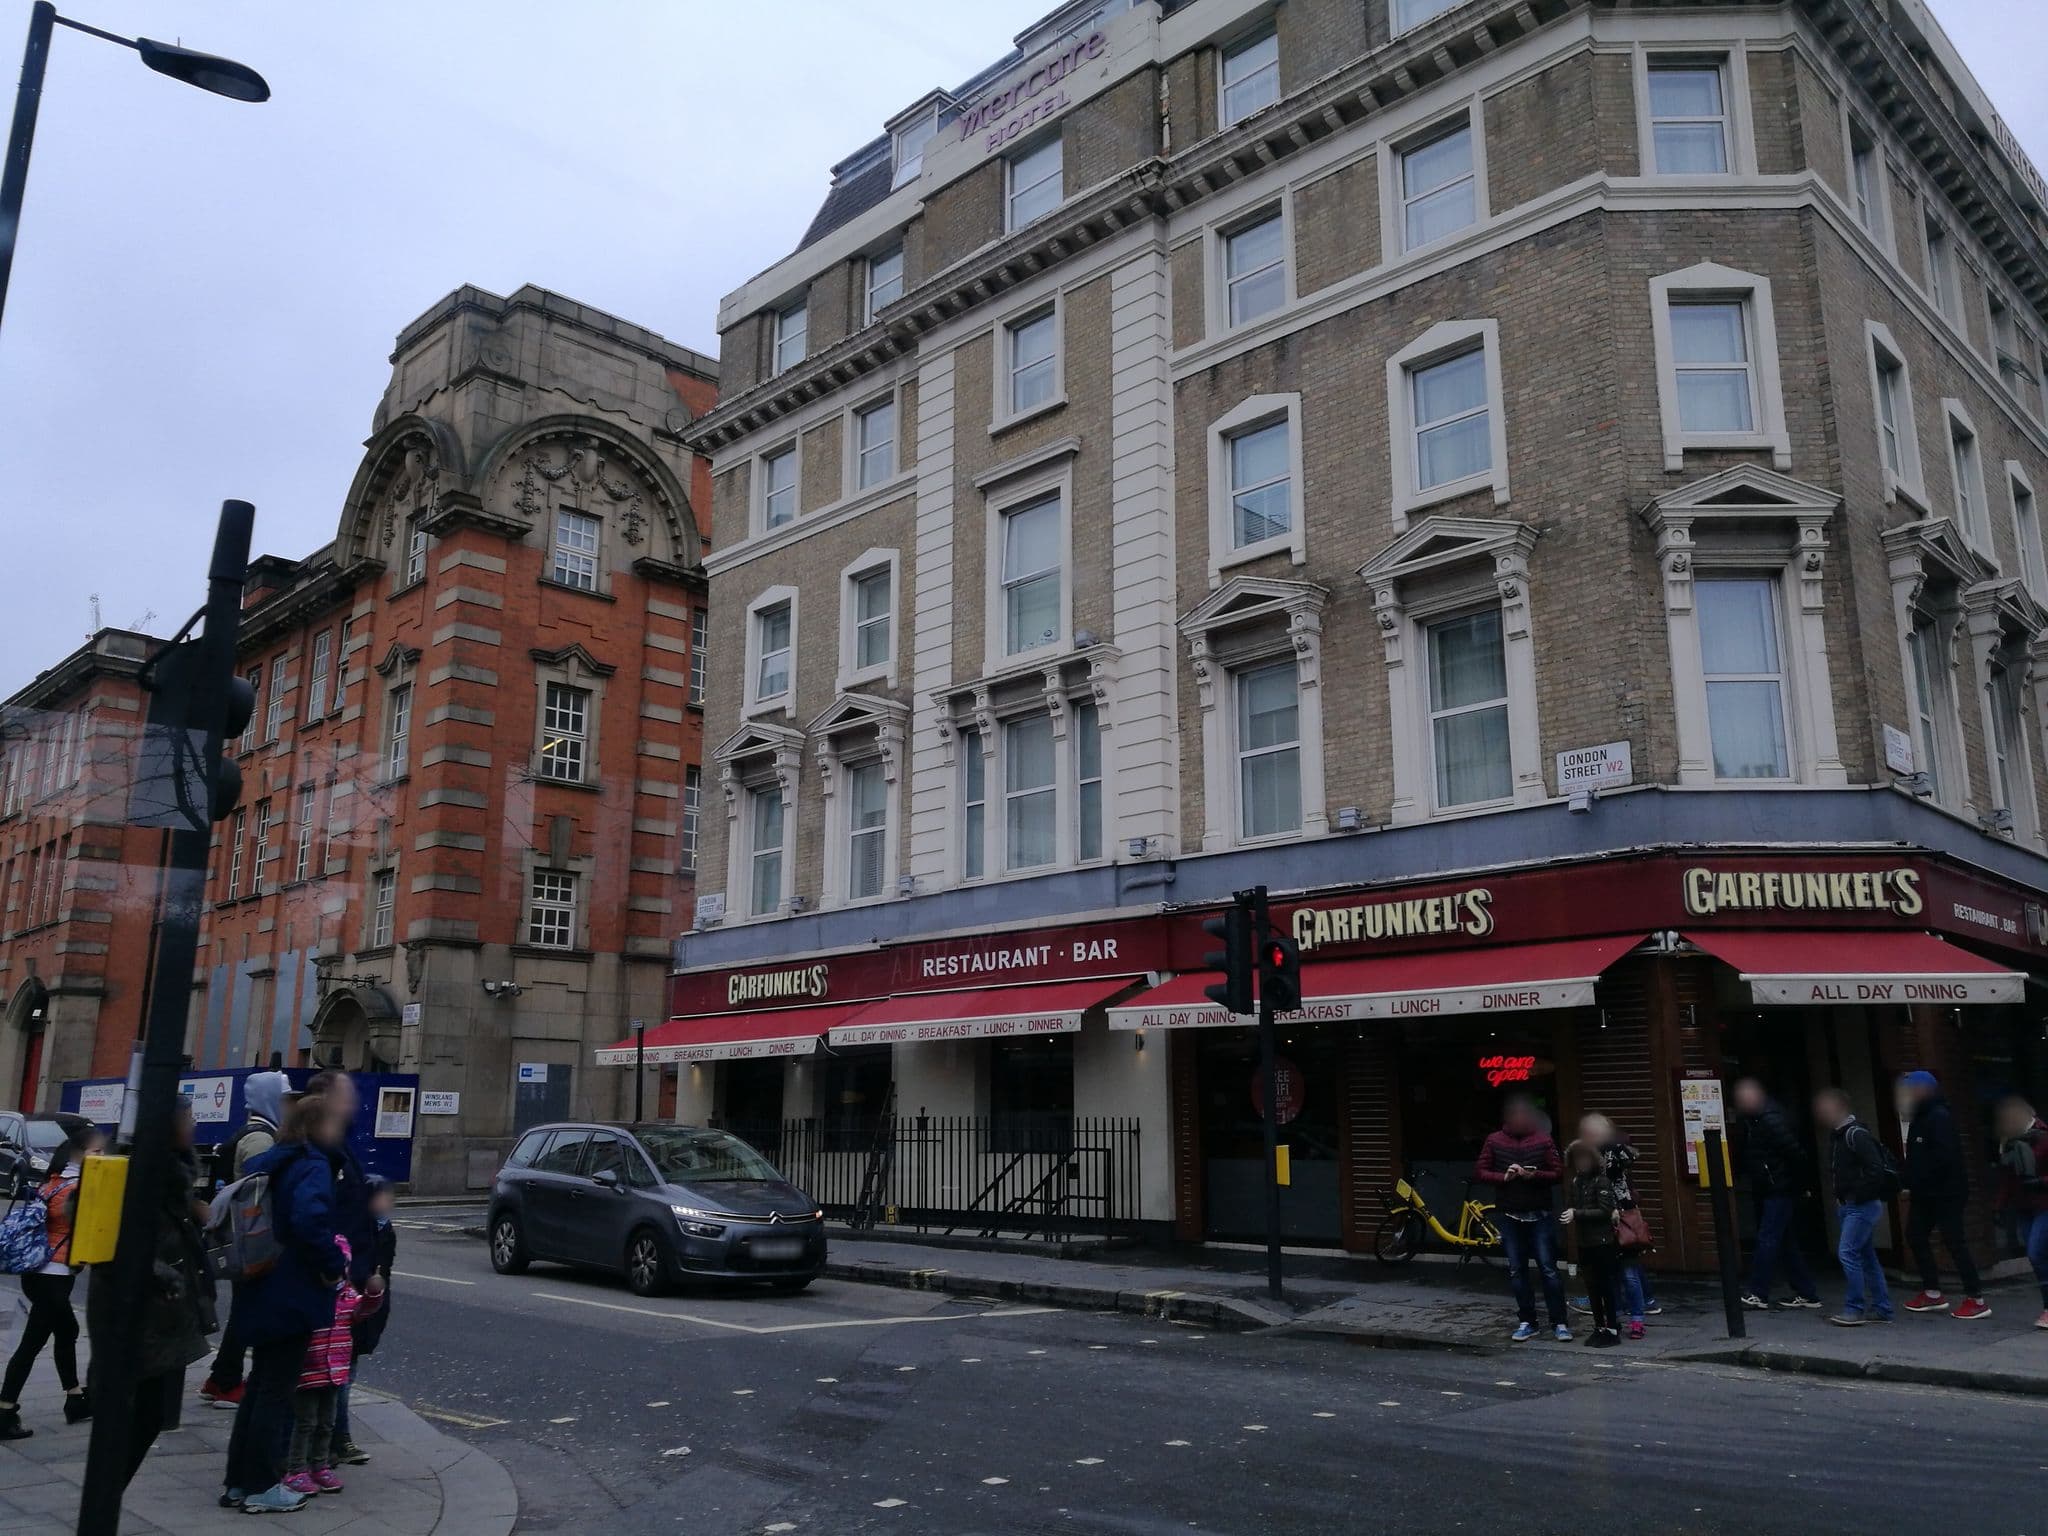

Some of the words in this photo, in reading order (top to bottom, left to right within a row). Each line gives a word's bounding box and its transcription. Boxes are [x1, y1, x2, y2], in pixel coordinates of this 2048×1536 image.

[986, 89, 1072, 153] HOTEL
[1563, 749, 1608, 767] LONDON
[1564, 763, 1602, 780] STREET
[1606, 760, 1624, 772] W2
[1682, 867, 1923, 916] GARFUNKEL'S
[1292, 888, 1494, 951] GARFUNKEL'S
[1953, 902, 1999, 930] RESTAURANT
[2003, 918, 2019, 935] BAR
[923, 945, 1052, 977] RESTAURANT
[1073, 938, 1119, 962] BAR
[728, 964, 829, 1005] GARFUNKEL'S
[1810, 984, 1849, 1001] ALL
[1857, 984, 1895, 1000] DAY
[1905, 984, 1968, 1000] DINING
[1142, 1014, 1164, 1027] ALL
[1169, 1013, 1190, 1025] DAY
[1197, 1011, 1237, 1024] DINING
[1391, 999, 1441, 1015] LUNCH
[1483, 991, 1541, 1008] DINNER
[842, 1032, 857, 1043] ALL
[861, 1031, 877, 1041] DAY
[880, 1030, 907, 1041] DINING
[918, 1024, 972, 1038] BREAKFAST
[984, 1022, 1015, 1034] LUNCH
[1028, 1018, 1064, 1031] DINNER
[612, 1053, 625, 1063] ALL
[626, 1053, 638, 1062] DAY
[674, 1049, 713, 1060] BREAKFAST
[729, 1046, 753, 1057] LUNCH
[769, 1043, 796, 1055] DINNER
[1479, 1055, 1503, 1069] we
[1504, 1056, 1536, 1069] are
[1487, 1069, 1530, 1088] open
